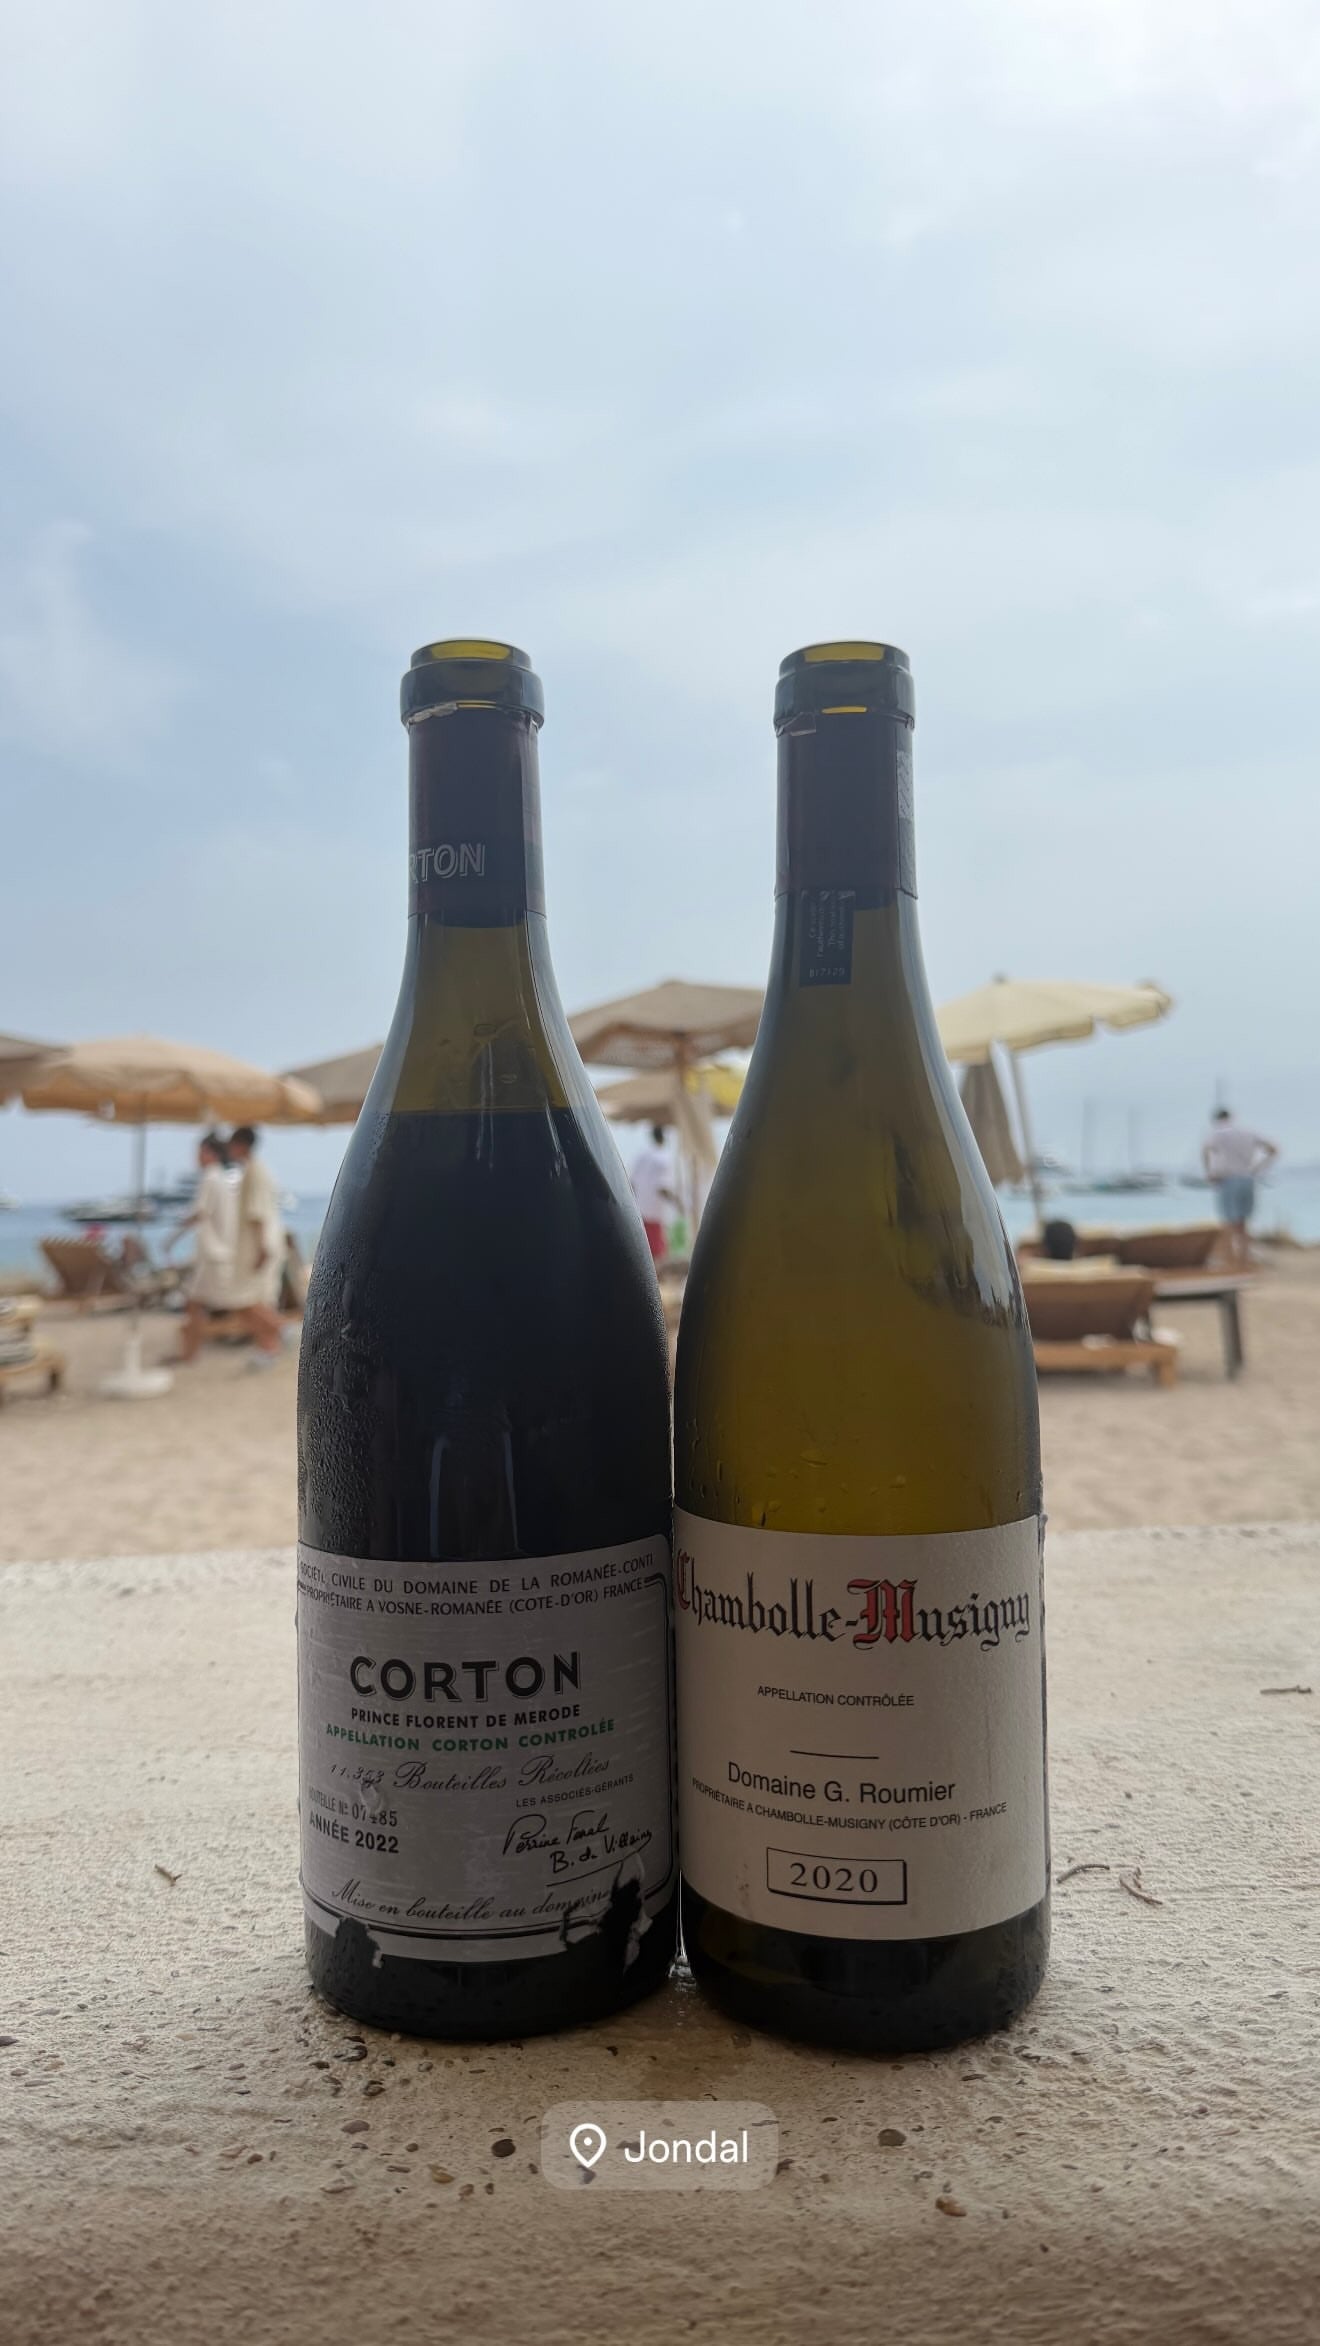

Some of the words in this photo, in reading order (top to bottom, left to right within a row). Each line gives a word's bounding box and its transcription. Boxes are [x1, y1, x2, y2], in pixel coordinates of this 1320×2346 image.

[331, 1572, 366, 1590] CIVILE
[374, 1578, 393, 1593] DU
[403, 1580, 478, 1595] DOMAINE
[490, 1579, 510, 1593] DE
[521, 1576, 540, 1591] LA
[551, 1552, 653, 1587] ROMANÉE-CONTI
[378, 1599, 502, 1616] VOSNE-ROMANÉE
[603, 1577, 643, 1599] FRANCE
[677, 1548, 1031, 1651] Chambolle-Musigny
[350, 1651, 581, 1702] CORTON
[757, 1685, 834, 1705] APPELLATION
[837, 1693, 915, 1707] CONTRÔLÉE
[351, 1707, 399, 1727] PRINCE
[406, 1714, 479, 1729] FLORENT
[486, 1714, 507, 1727] DE
[514, 1704, 581, 1726] MERODE
[326, 1723, 419, 1750] APPELLATION
[432, 1737, 508, 1752] CORTON
[393, 1761, 507, 1790] Bouteilles
[728, 1762, 816, 1799] Domaine
[823, 1781, 850, 1802] G.
[859, 1780, 956, 1804] Roumier
[516, 1797, 536, 1808] LES
[755, 1804, 885, 1830] CHAMBOLLE-MUSIGNY
[888, 1815, 927, 1832] (CÔTE
[929, 1813, 961, 1827] D'OR)
[969, 1801, 1008, 1821] FRANCE
[309, 1811, 350, 1843] ANNÉE
[355, 1829, 399, 1854] 2022
[790, 1862, 878, 1894] 2020
[331, 1878, 376, 1909] Mise
[379, 1902, 401, 1916] en
[405, 1896, 495, 1921] bouteille
[499, 1907, 527, 1918] au
